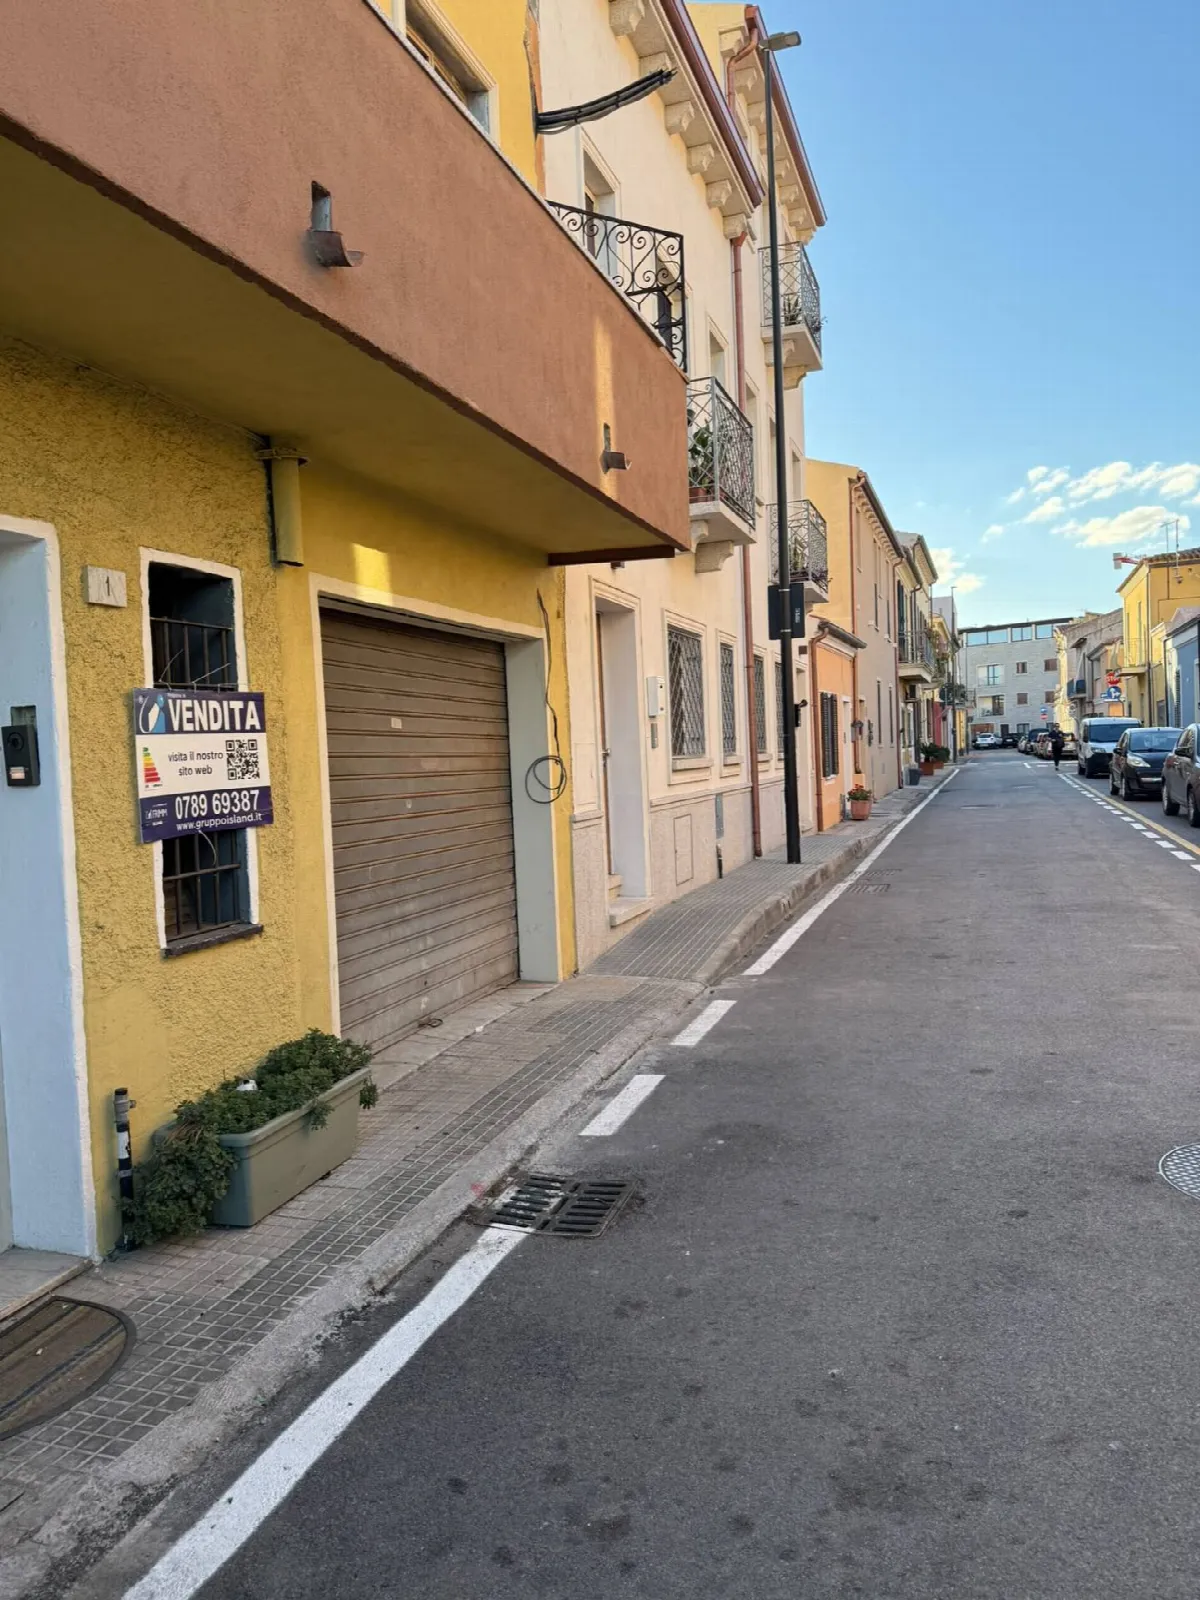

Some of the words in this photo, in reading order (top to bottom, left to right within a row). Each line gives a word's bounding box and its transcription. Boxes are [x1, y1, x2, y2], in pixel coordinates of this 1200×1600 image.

[105, 576, 110, 596] 1
[168, 699, 261, 731] VENDITA
[168, 752, 188, 762] visita
[189, 751, 195, 760] il
[196, 752, 224, 760] nostro
[178, 766, 193, 776] sito
[195, 765, 213, 775] web
[175, 794, 208, 820] 0789
[212, 789, 260, 815] 69387
[176, 813, 262, 831] www.gruppoisland.it
